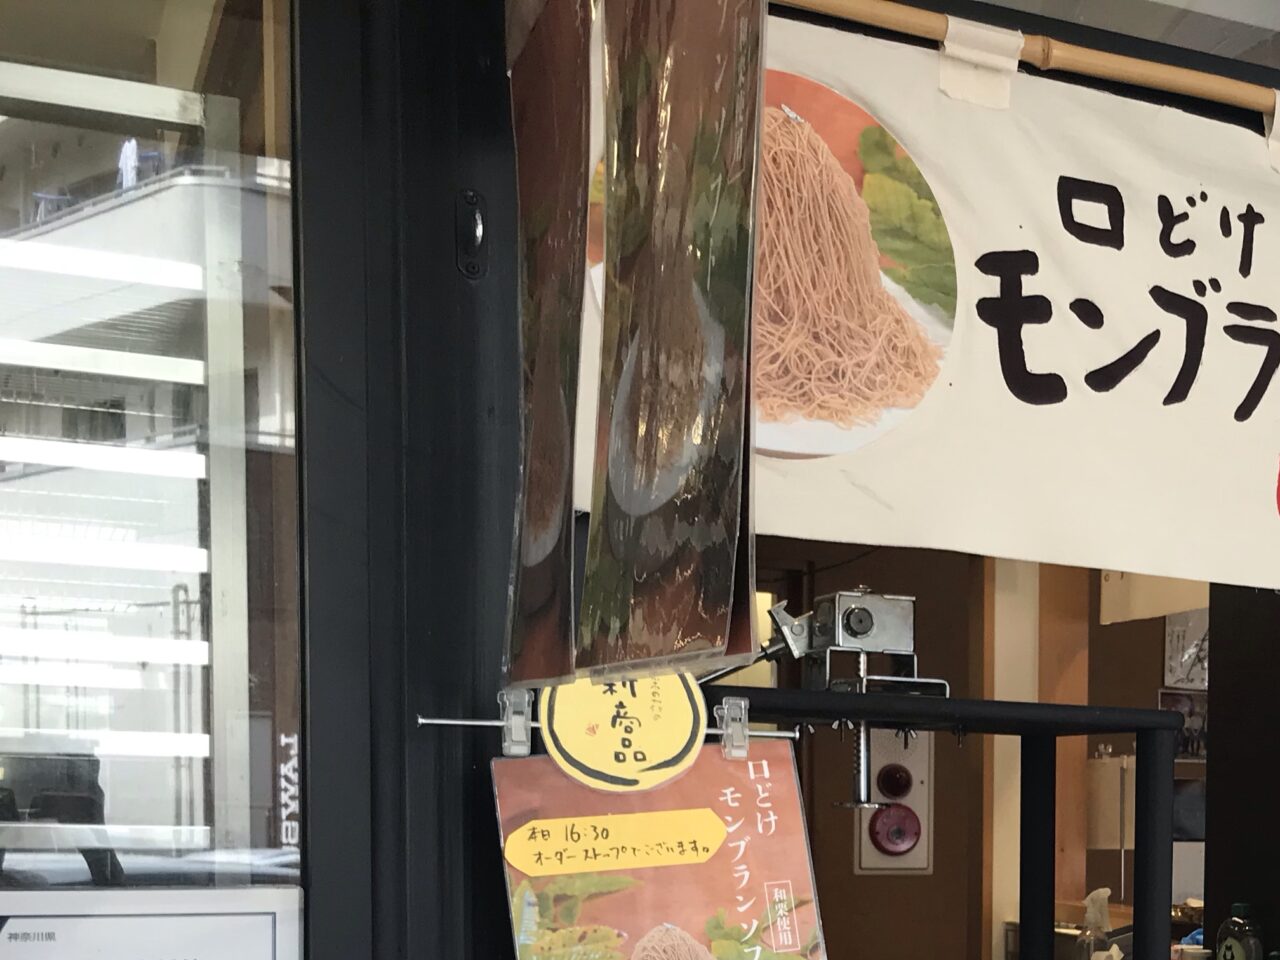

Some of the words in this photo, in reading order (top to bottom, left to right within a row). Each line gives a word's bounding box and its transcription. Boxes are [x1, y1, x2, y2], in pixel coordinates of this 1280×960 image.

[1057, 175, 1265, 278] 口どけ
[747, 759, 778, 837] 口どけ
[527, 826, 552, 842] 本日
[564, 822, 610, 843] 16:30
[7, 931, 57, 943] 神奈川県
[772, 887, 793, 947] 和栗使用
